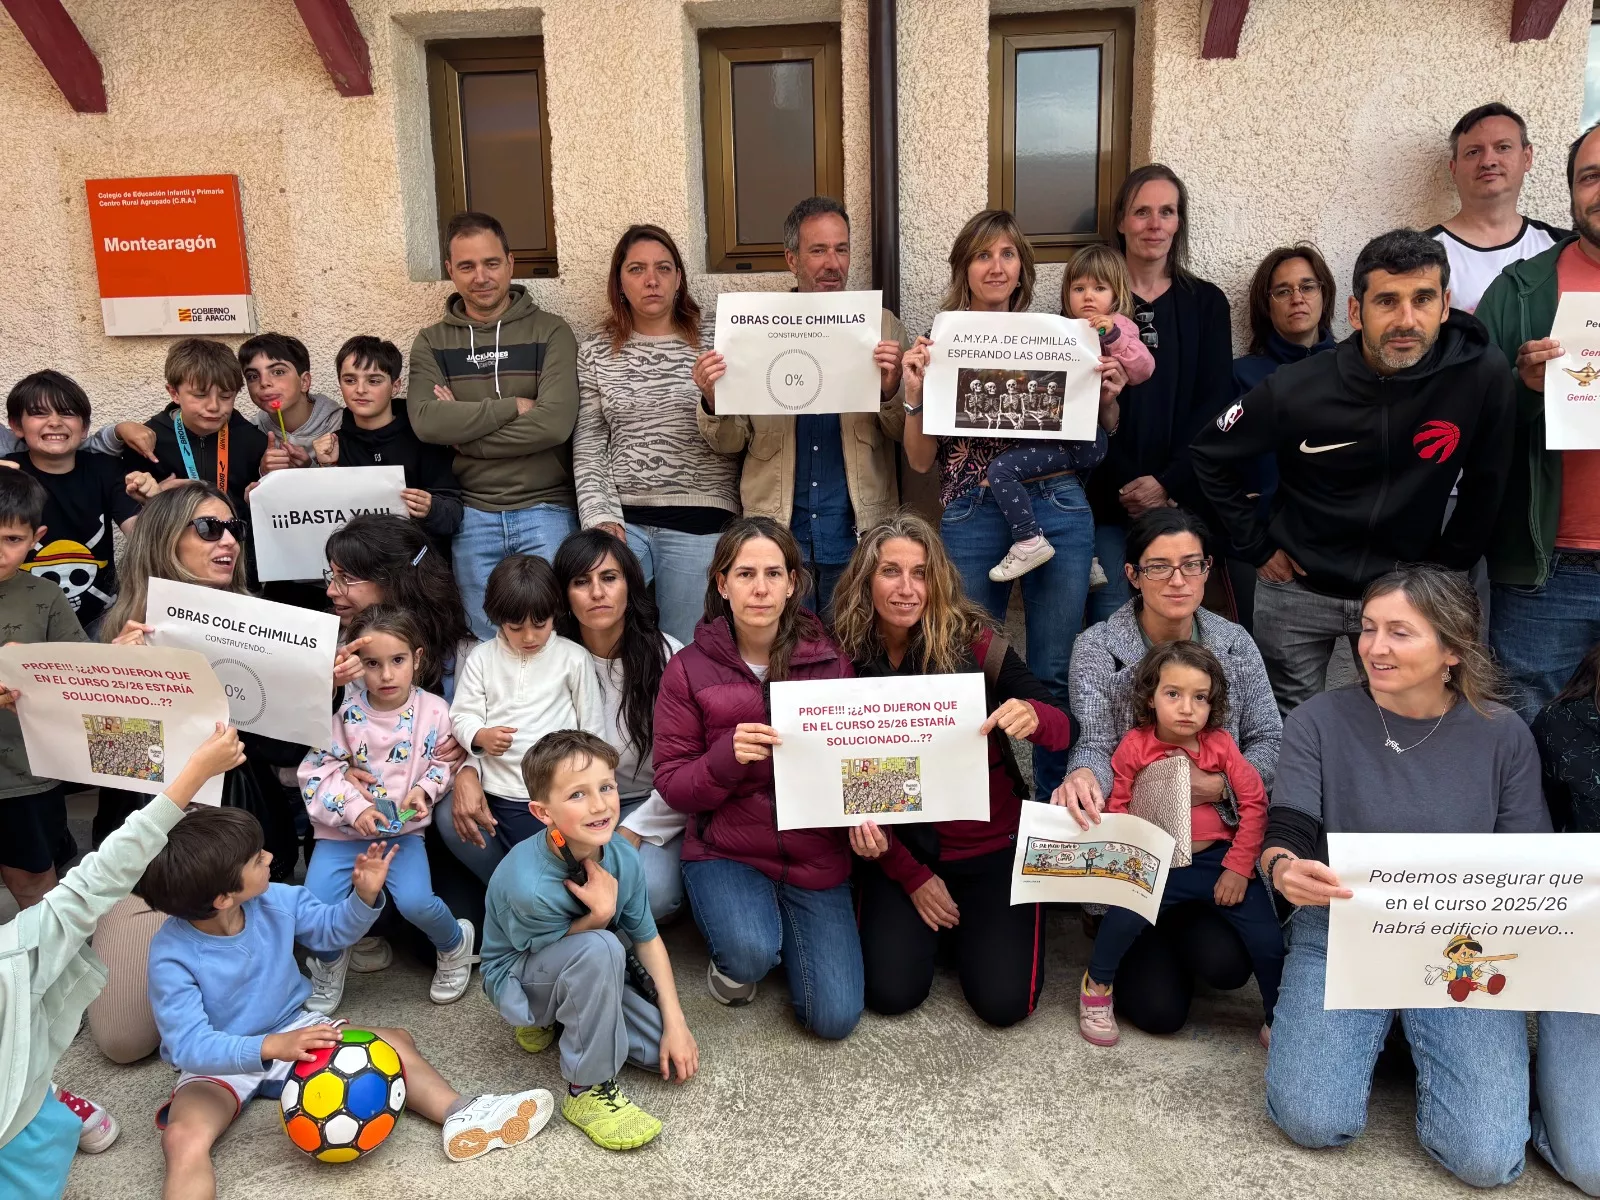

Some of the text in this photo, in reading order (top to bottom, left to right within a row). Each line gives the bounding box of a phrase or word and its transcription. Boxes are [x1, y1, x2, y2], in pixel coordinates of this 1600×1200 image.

[140, 198, 170, 206] Agrupado
[172, 197, 196, 206] (C.R.A.)
[104, 235, 216, 252] Montearagón
[192, 307, 230, 315] GOBIERNO
[730, 314, 866, 325] OBRAS COLE CHIMILLAS
[1586, 320, 1600, 328] Pe
[1020, 336, 1077, 346] CHIMILLAS
[948, 349, 1080, 362] ESPERANDO LAS OBRAS...
[784, 374, 804, 386] 0%
[1567, 393, 1598, 402] Genio:
[272, 510, 346, 528] ¡¡¡BASTA
[167, 606, 318, 650] OBRAS COLE CHIMILLAS
[22, 662, 74, 672] PROFE!!!
[112, 666, 162, 680] DIJERON
[165, 670, 192, 681] QUE
[34, 674, 194, 695] EN EL CURSO 25/26 ESTARÍA
[62, 690, 172, 708] SOLUCIONADO...??
[224, 684, 246, 702] 0%
[799, 705, 845, 716] PROFE!!!
[884, 702, 931, 713] DIJERON
[934, 701, 958, 711] QUE
[802, 716, 956, 732] EN EL CURSO 25/26 ESTARÍA
[826, 734, 932, 746] SOLUCIONADO...??
[1369, 870, 1584, 888] Podemos asegurar que
[1386, 896, 1568, 912] en el curso 2025/26
[1372, 920, 1574, 936] habrá edificio nuevo...
